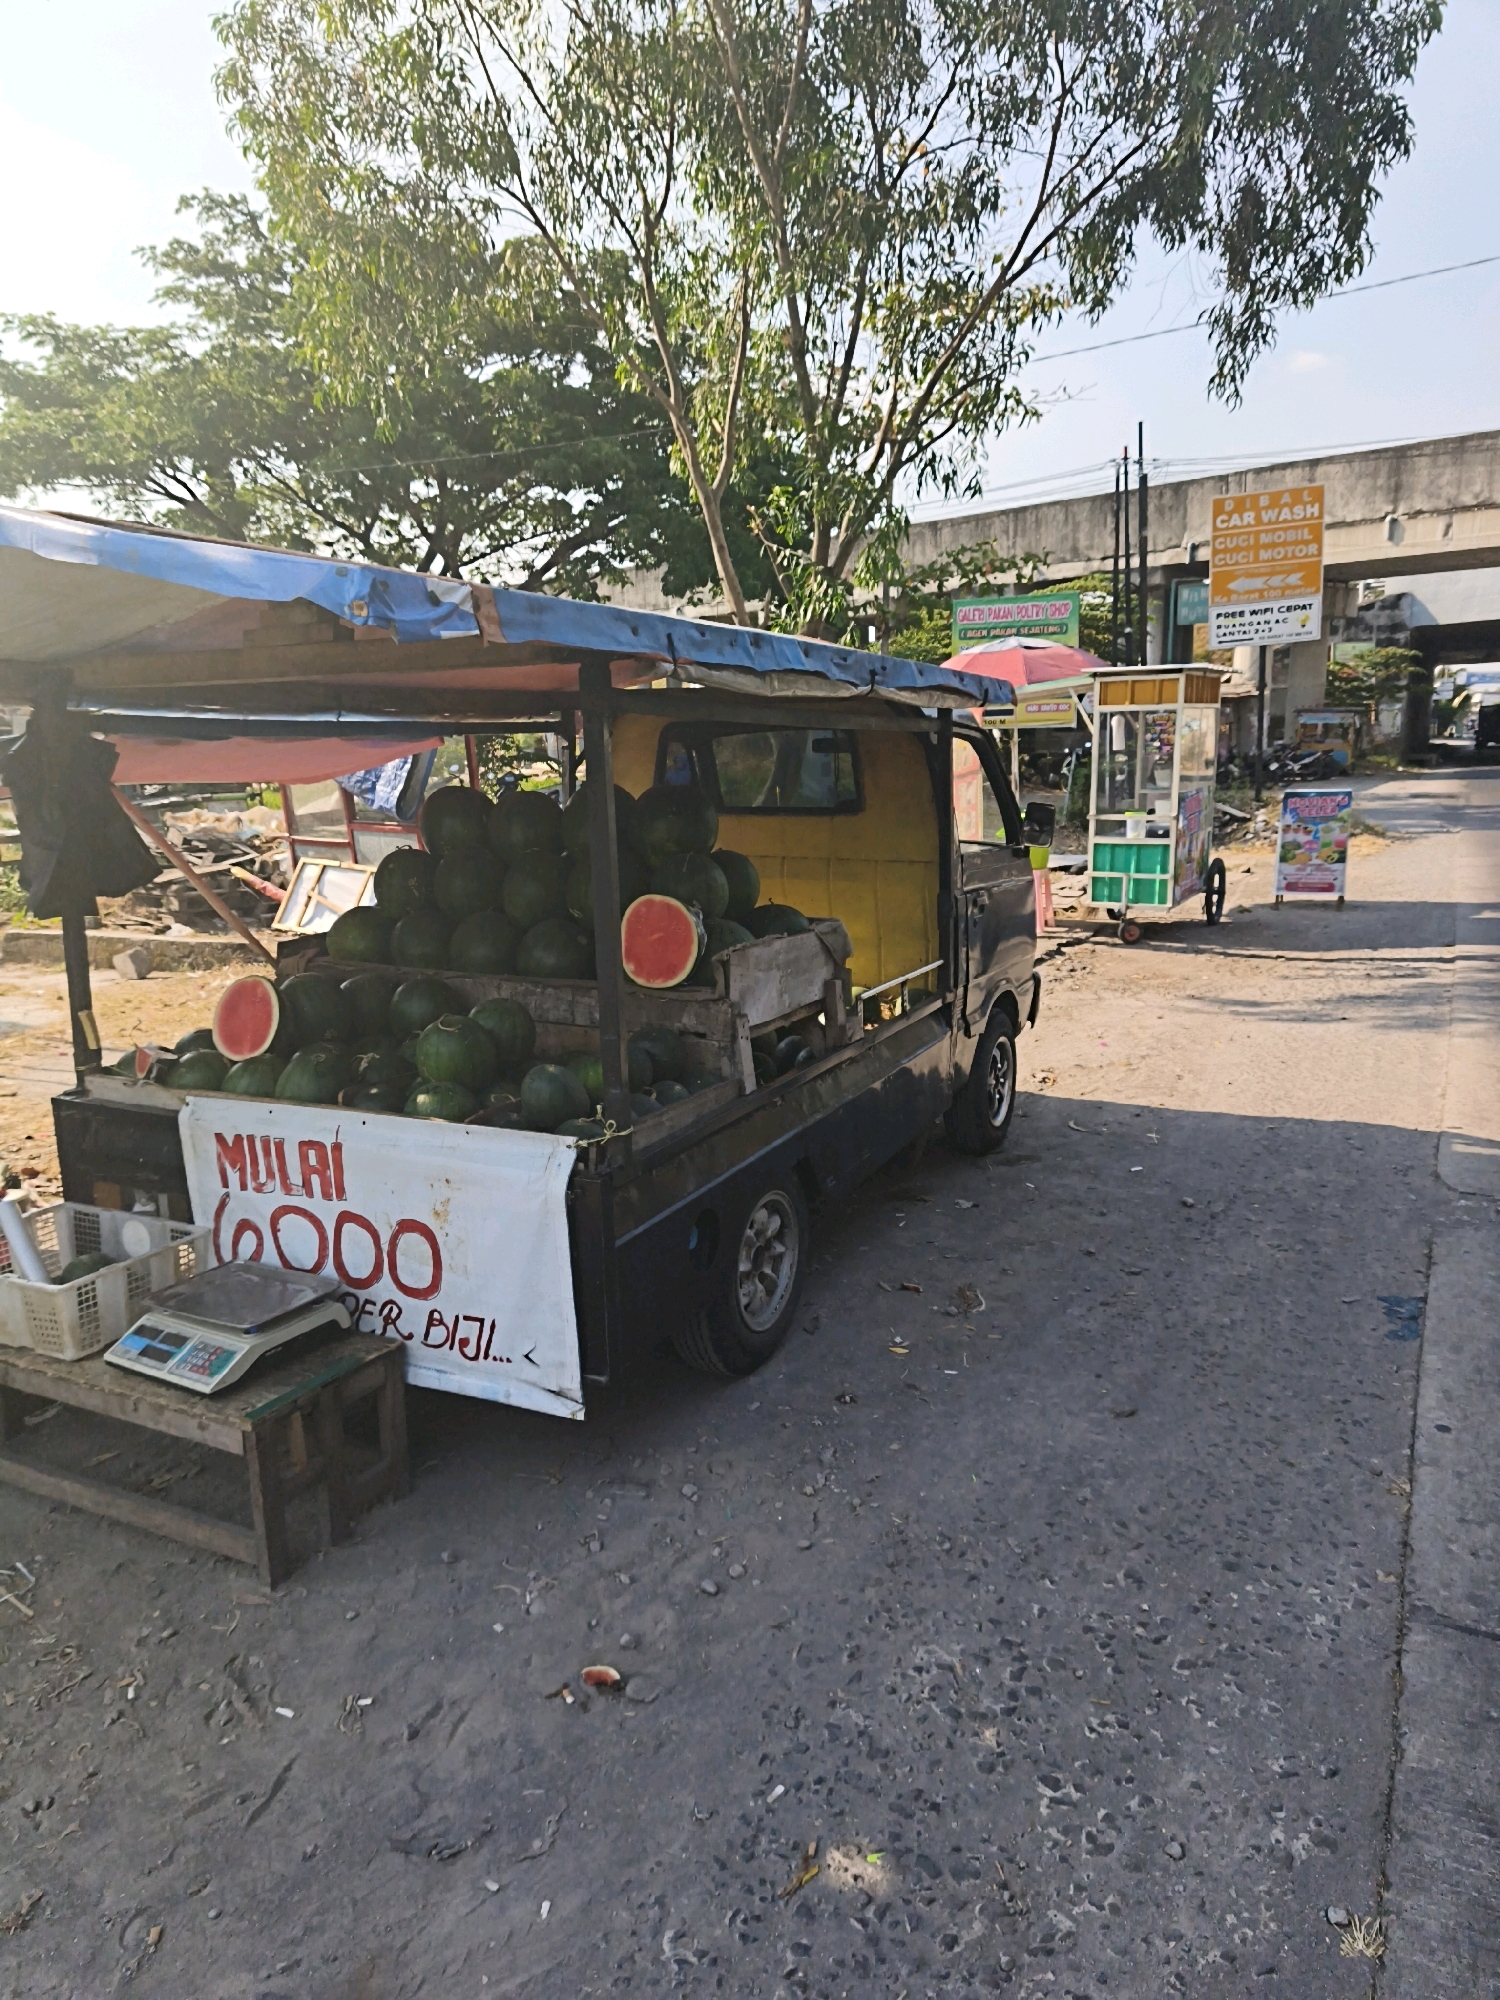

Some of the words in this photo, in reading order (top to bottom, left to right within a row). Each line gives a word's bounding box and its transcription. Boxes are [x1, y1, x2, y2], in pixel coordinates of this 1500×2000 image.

[1215, 511, 1256, 529] CAR
[1261, 503, 1319, 523] WASH
[1214, 534, 1254, 550] CUCI
[1260, 528, 1313, 545] MOBIL
[1214, 551, 1254, 566] CUCI
[1260, 543, 1318, 560] MOTOR
[1048, 600, 1072, 618] SHOP
[1216, 610, 1245, 619] FREE
[1249, 607, 1274, 616] WIFI
[1278, 603, 1313, 613] CEPAT
[213, 1126, 347, 1202] MULAI
[212, 1191, 443, 1300] 6000
[340, 1292, 414, 1342] PER
